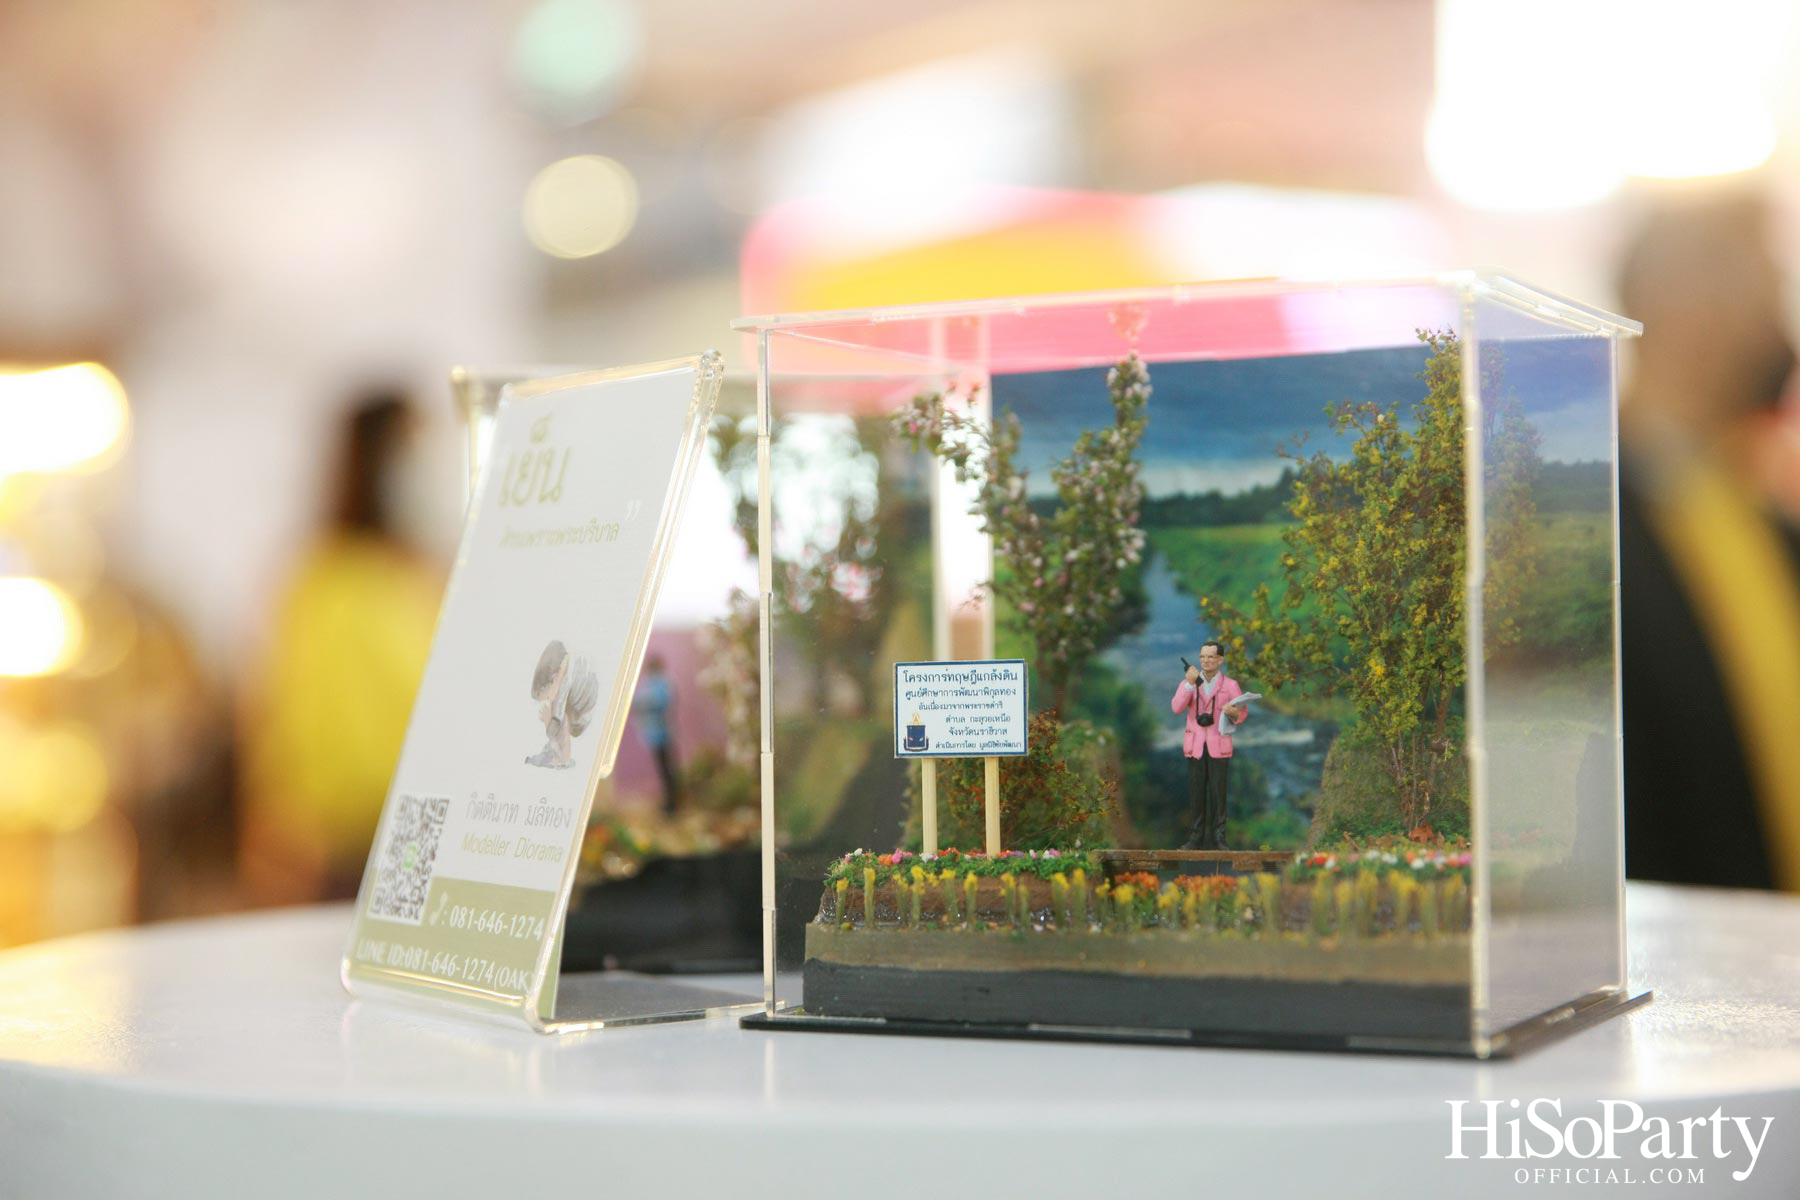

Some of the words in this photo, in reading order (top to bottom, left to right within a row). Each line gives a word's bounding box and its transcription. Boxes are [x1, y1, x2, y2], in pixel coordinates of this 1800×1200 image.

[498, 411, 572, 507] เย็น
[462, 832, 510, 856] Modeller
[514, 837, 564, 863] Diorama
[358, 938, 386, 963] LINE
